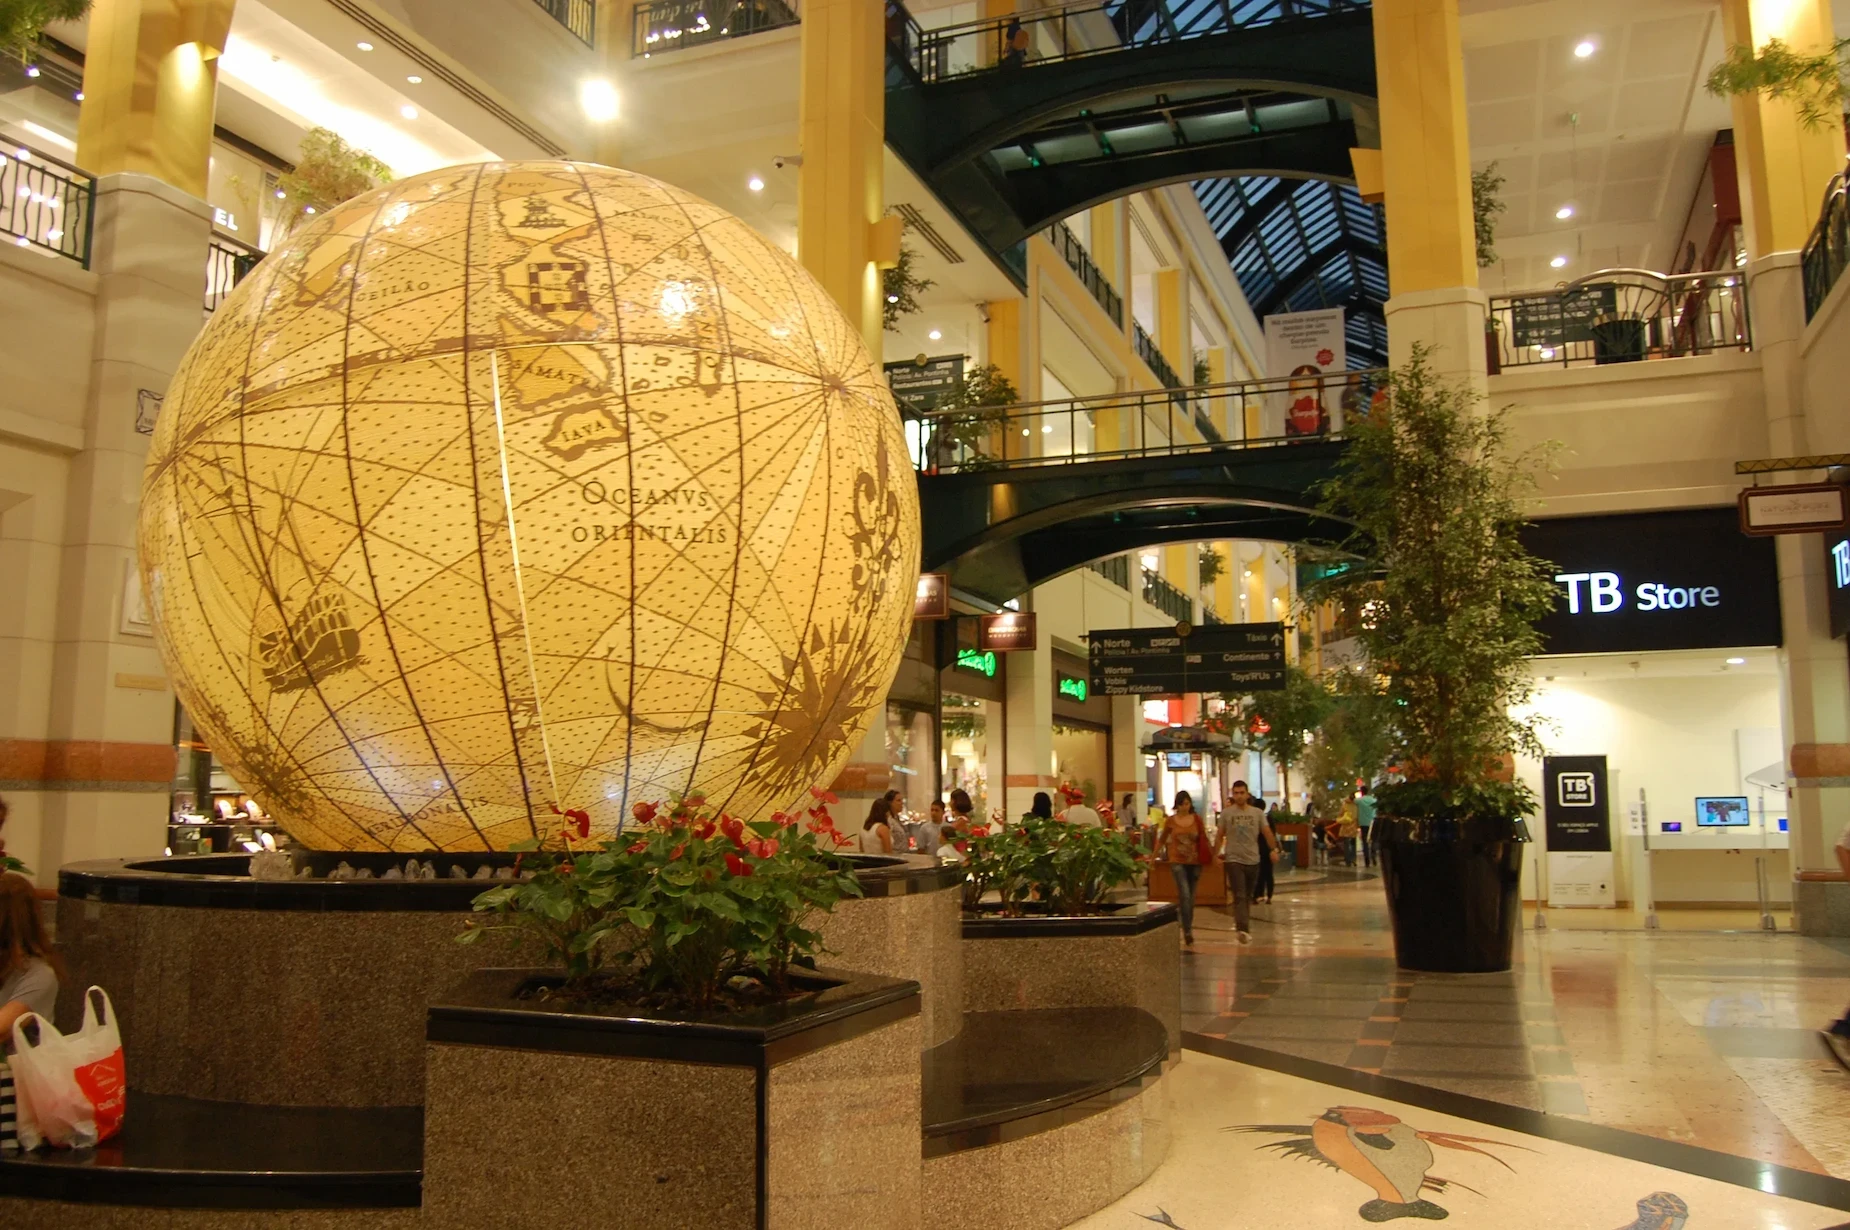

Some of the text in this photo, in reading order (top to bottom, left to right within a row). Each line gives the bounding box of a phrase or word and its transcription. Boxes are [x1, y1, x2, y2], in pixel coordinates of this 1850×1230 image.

[210, 205, 239, 232] EL
[561, 421, 607, 442] IAVA
[582, 480, 709, 507] OCEANVS
[572, 524, 727, 544] ORIENTALIS
[1555, 572, 1720, 614] TB Store
[1104, 638, 1131, 648] Norte
[1223, 652, 1270, 662] Continente
[1104, 666, 1134, 675] Worten
[1104, 677, 1127, 685] Vobis
[1105, 684, 1164, 695] Zippy Kidstore
[1564, 778, 1588, 792] TB
